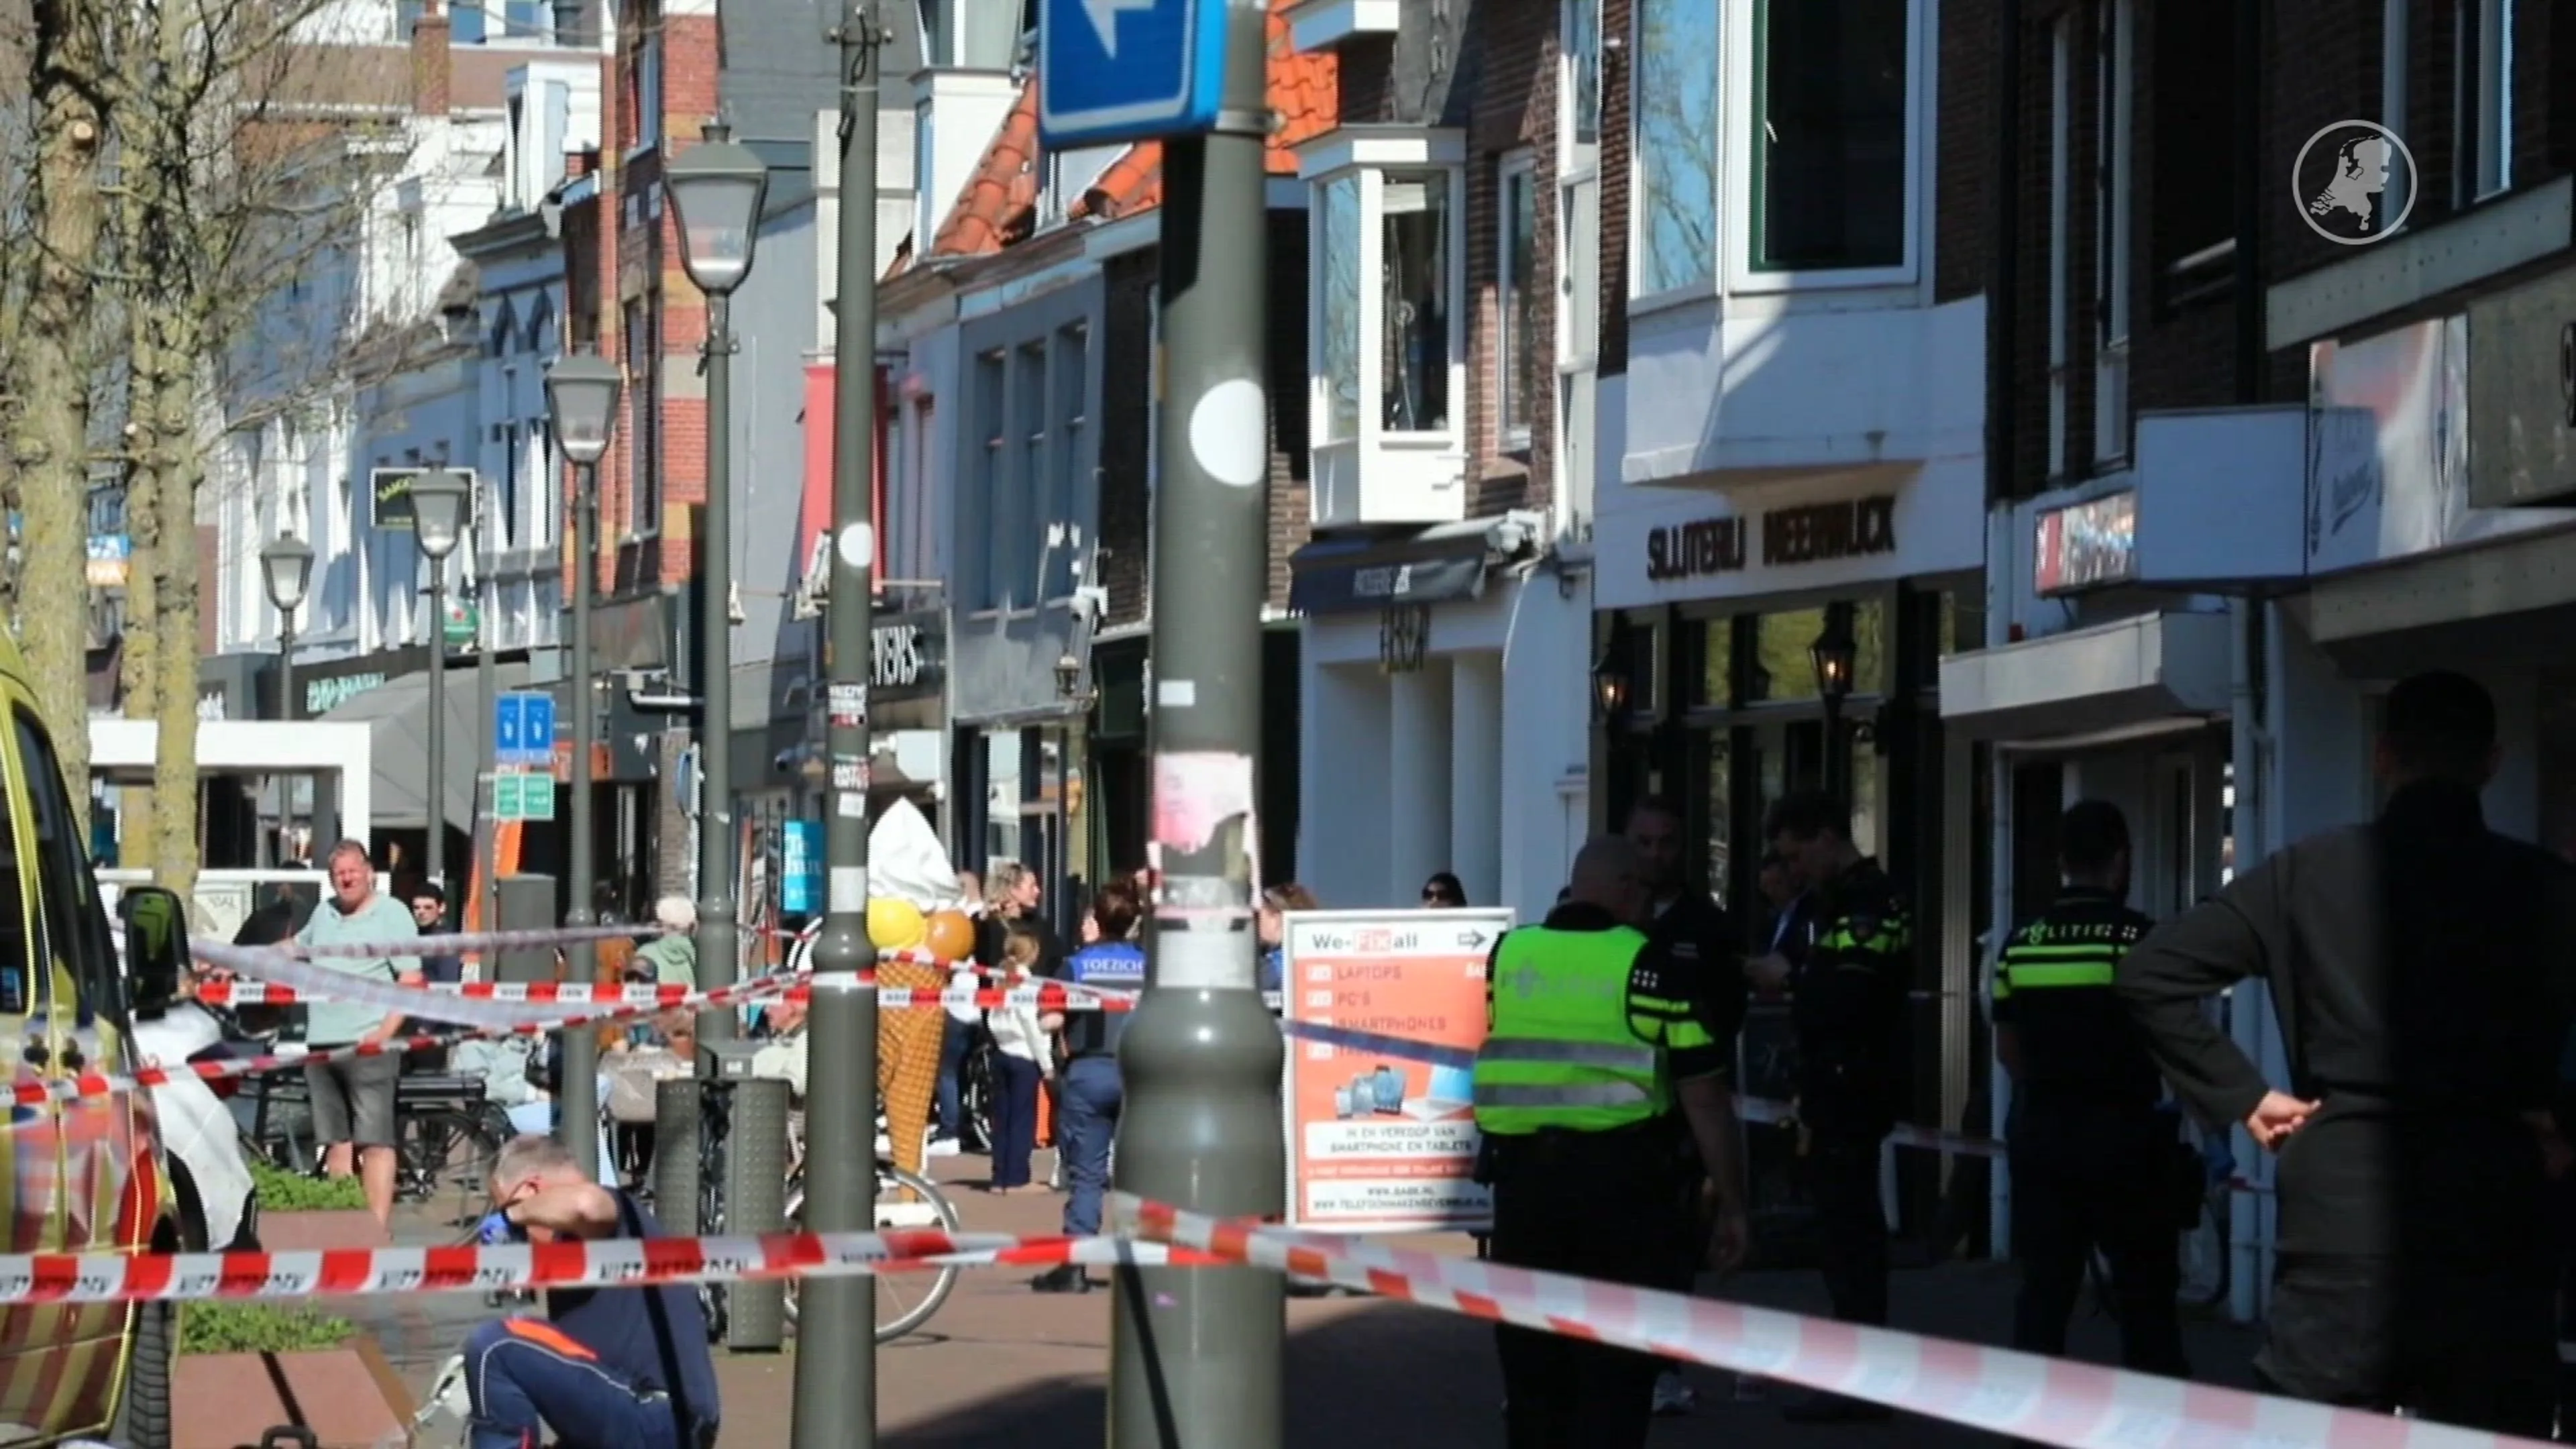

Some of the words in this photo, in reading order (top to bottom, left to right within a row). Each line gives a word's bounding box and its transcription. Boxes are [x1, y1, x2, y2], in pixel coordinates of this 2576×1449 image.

[1081, 957, 1144, 973] TOEZICH
[1337, 965, 1402, 981] LAPTOPS
[1331, 1142, 1403, 1152] SMARTPHONE
[1426, 1140, 1472, 1151] TABLETS
